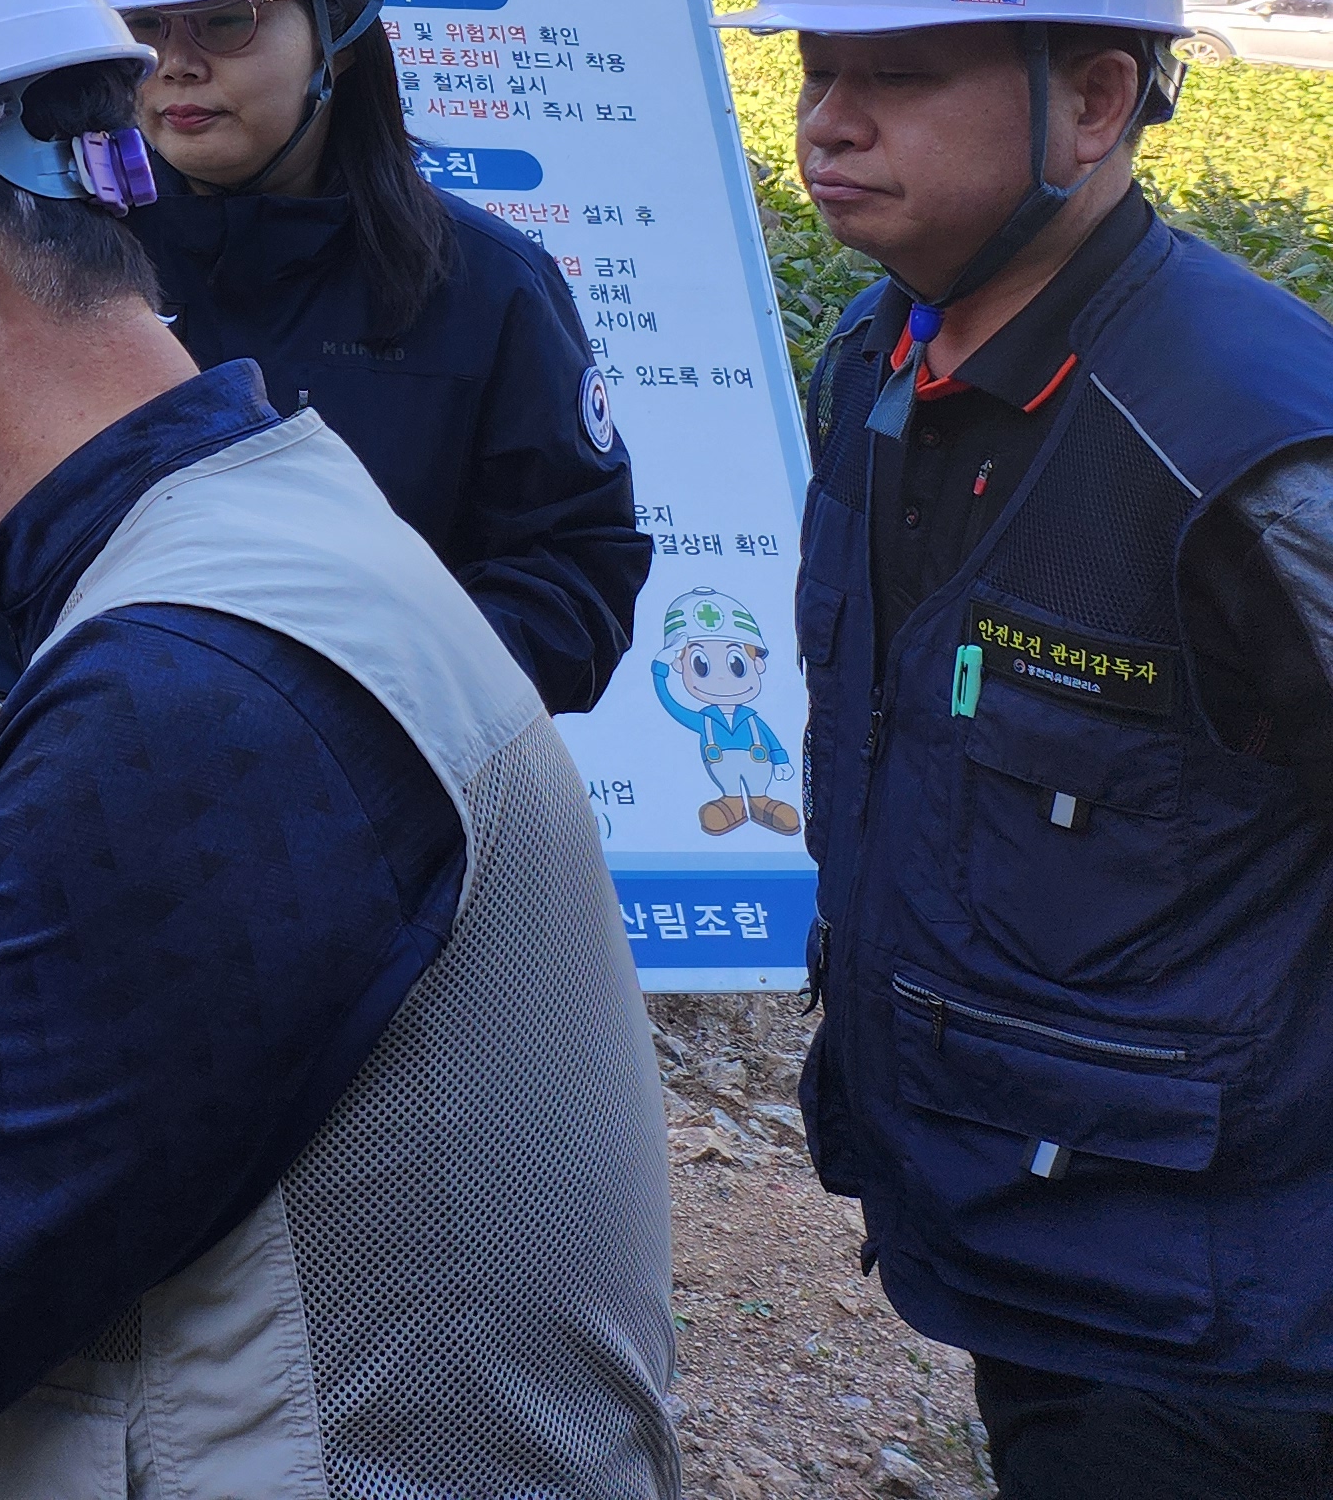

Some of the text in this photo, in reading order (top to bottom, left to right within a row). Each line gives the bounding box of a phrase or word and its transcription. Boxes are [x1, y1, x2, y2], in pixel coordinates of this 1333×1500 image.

[413, 22, 432, 41] 및
[445, 23, 527, 44] 위험지역
[538, 26, 580, 47] 확인
[512, 51, 574, 72] 반드시
[585, 52, 626, 73] 착용
[432, 72, 495, 94] 철저히
[506, 75, 548, 96] 실시
[427, 97, 531, 121] 사고발생시
[542, 101, 584, 122] 즉시
[595, 103, 637, 123] 보고
[582, 204, 623, 226] 설치
[634, 206, 656, 226] 후
[553, 256, 637, 279] 업 금지
[589, 283, 631, 305] 해체
[595, 311, 658, 334] 사이에
[636, 365, 699, 387] 있도록
[710, 367, 754, 389] 하여
[651, 533, 779, 557] 결상태 확인
[978, 618, 1158, 684] 안전보건 관리감독자
[1027, 663, 1102, 693] 홍천국유림관리소
[589, 780, 635, 805] 사업
[619, 902, 768, 940] 산림조합
